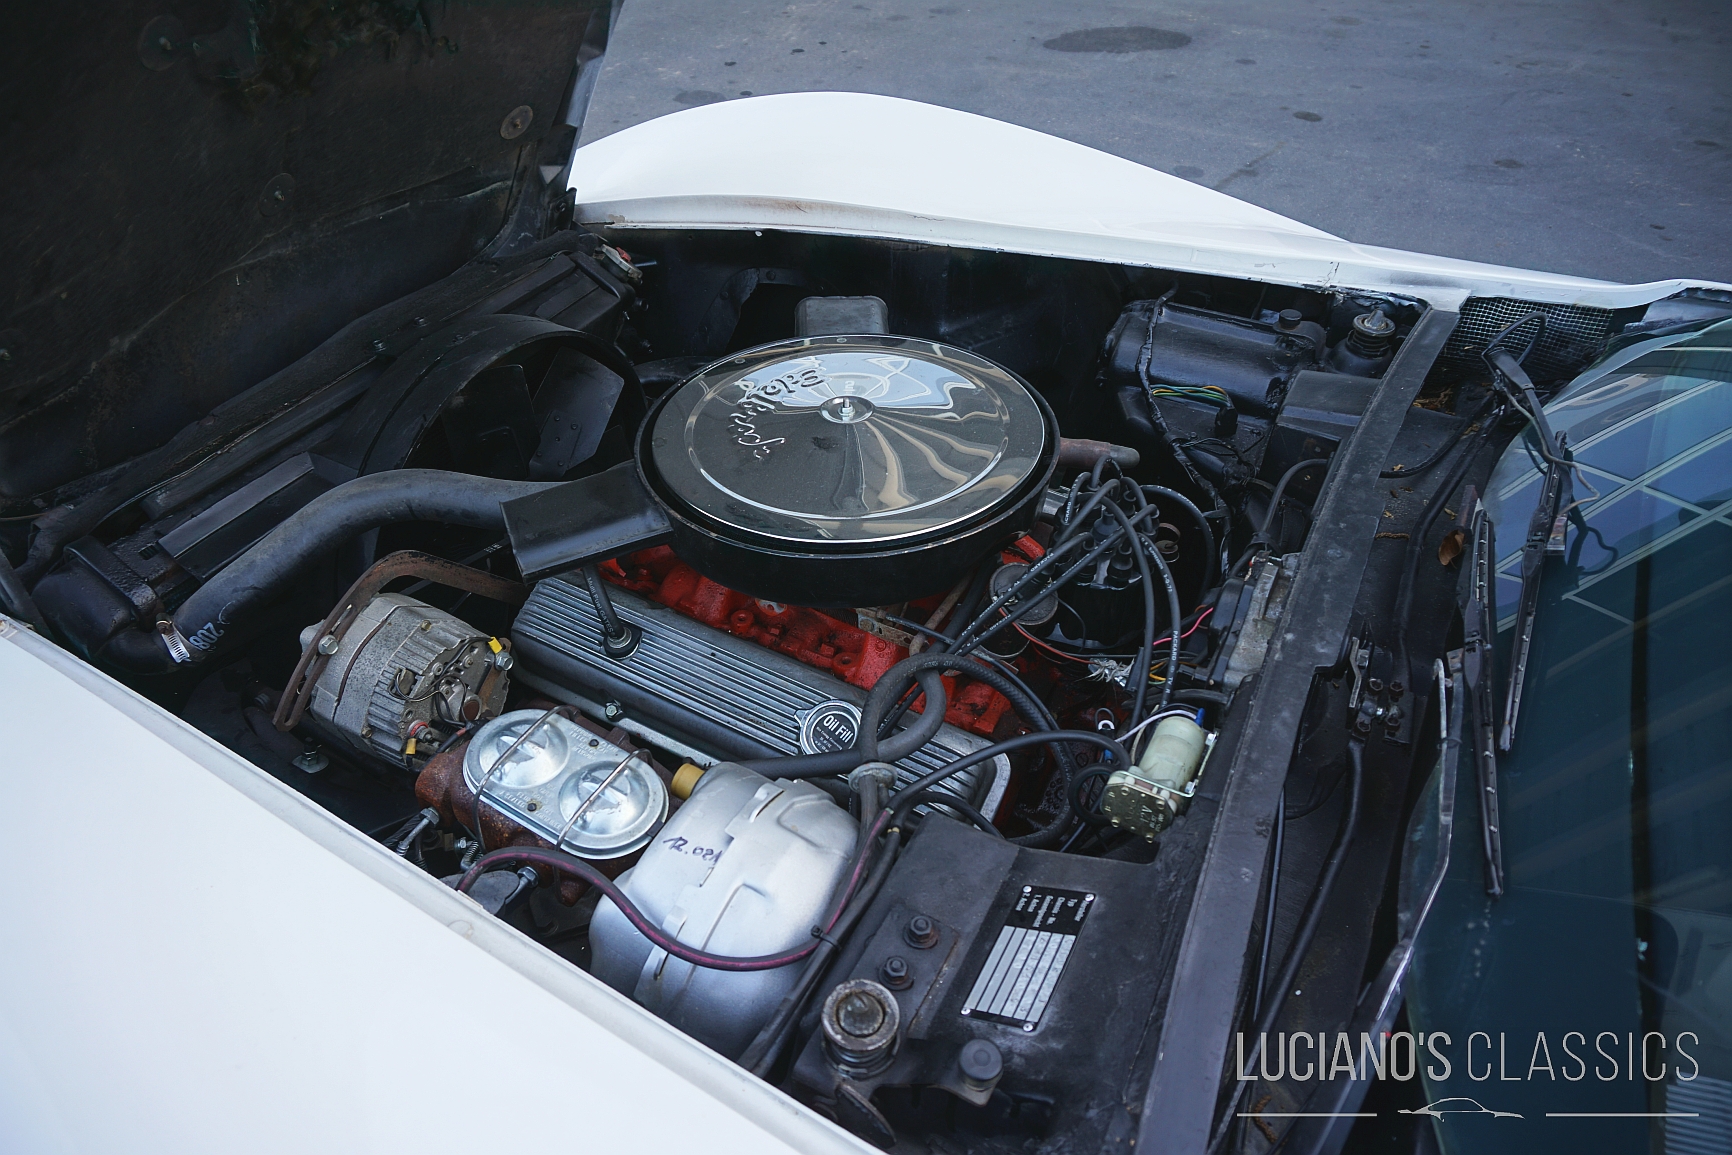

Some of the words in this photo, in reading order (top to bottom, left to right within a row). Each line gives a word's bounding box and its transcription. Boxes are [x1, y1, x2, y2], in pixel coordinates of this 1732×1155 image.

[600, 610, 614, 633] GATES
[189, 622, 224, 650] 208
[823, 715, 839, 731] Oil
[835, 725, 854, 743] Fill
